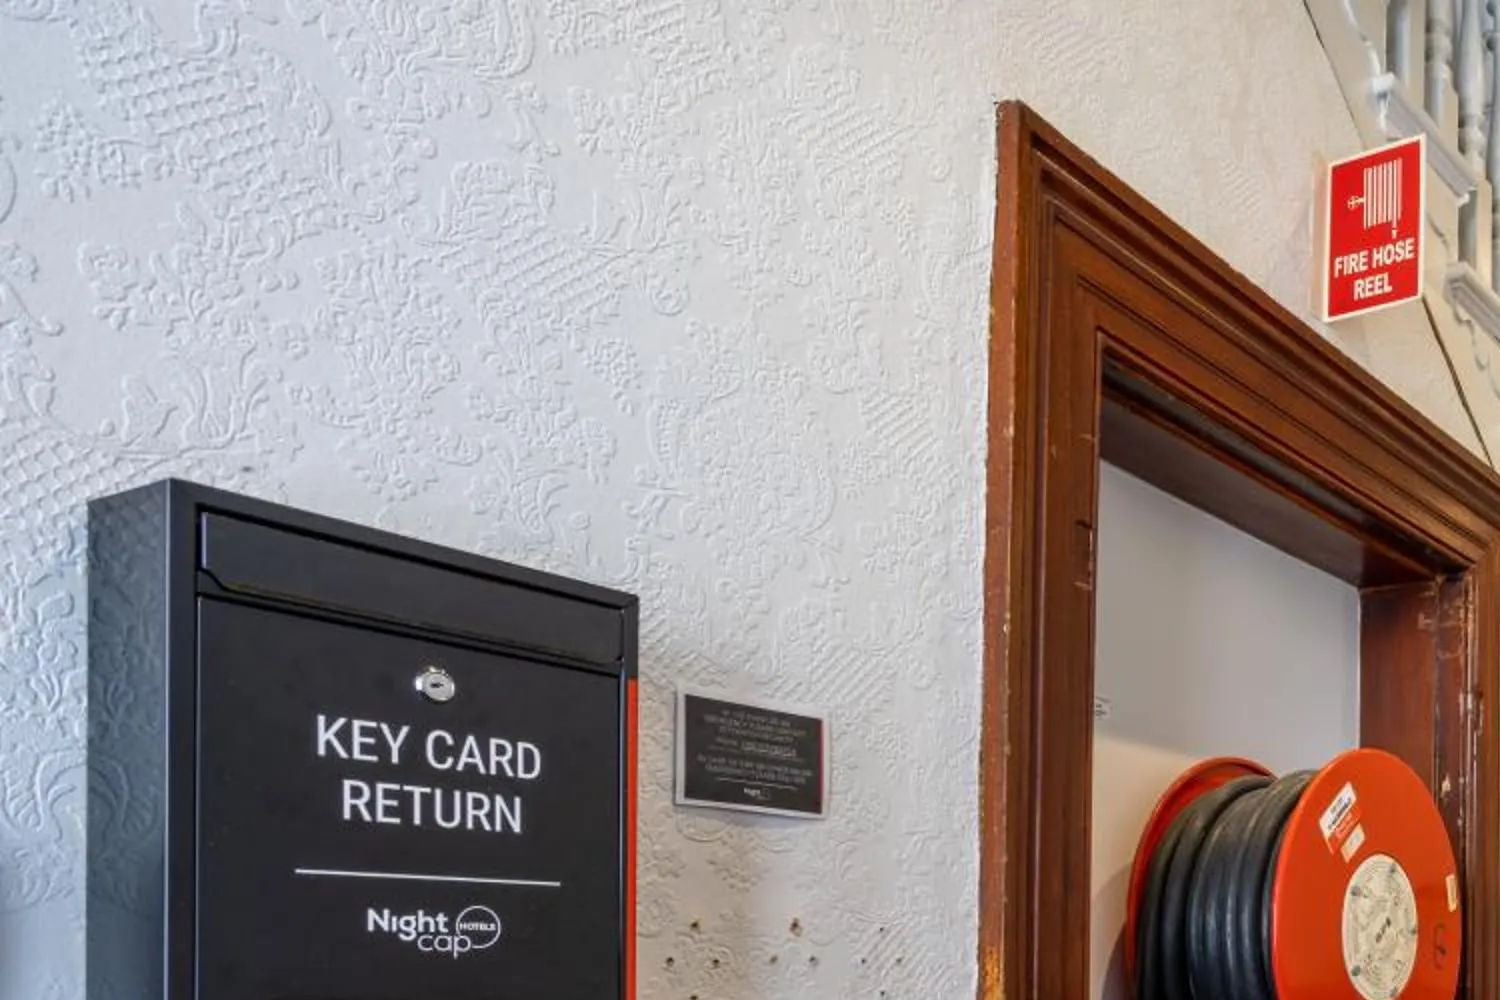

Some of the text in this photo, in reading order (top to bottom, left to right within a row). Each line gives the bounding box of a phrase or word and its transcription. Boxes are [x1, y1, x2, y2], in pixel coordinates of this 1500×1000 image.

[1334, 238, 1415, 278] FIRE HOSE
[1353, 272, 1393, 301] REEL
[316, 714, 542, 780] KEY CARD
[342, 779, 523, 834] RETURN
[366, 907, 449, 942] Night
[417, 934, 472, 960] cap
